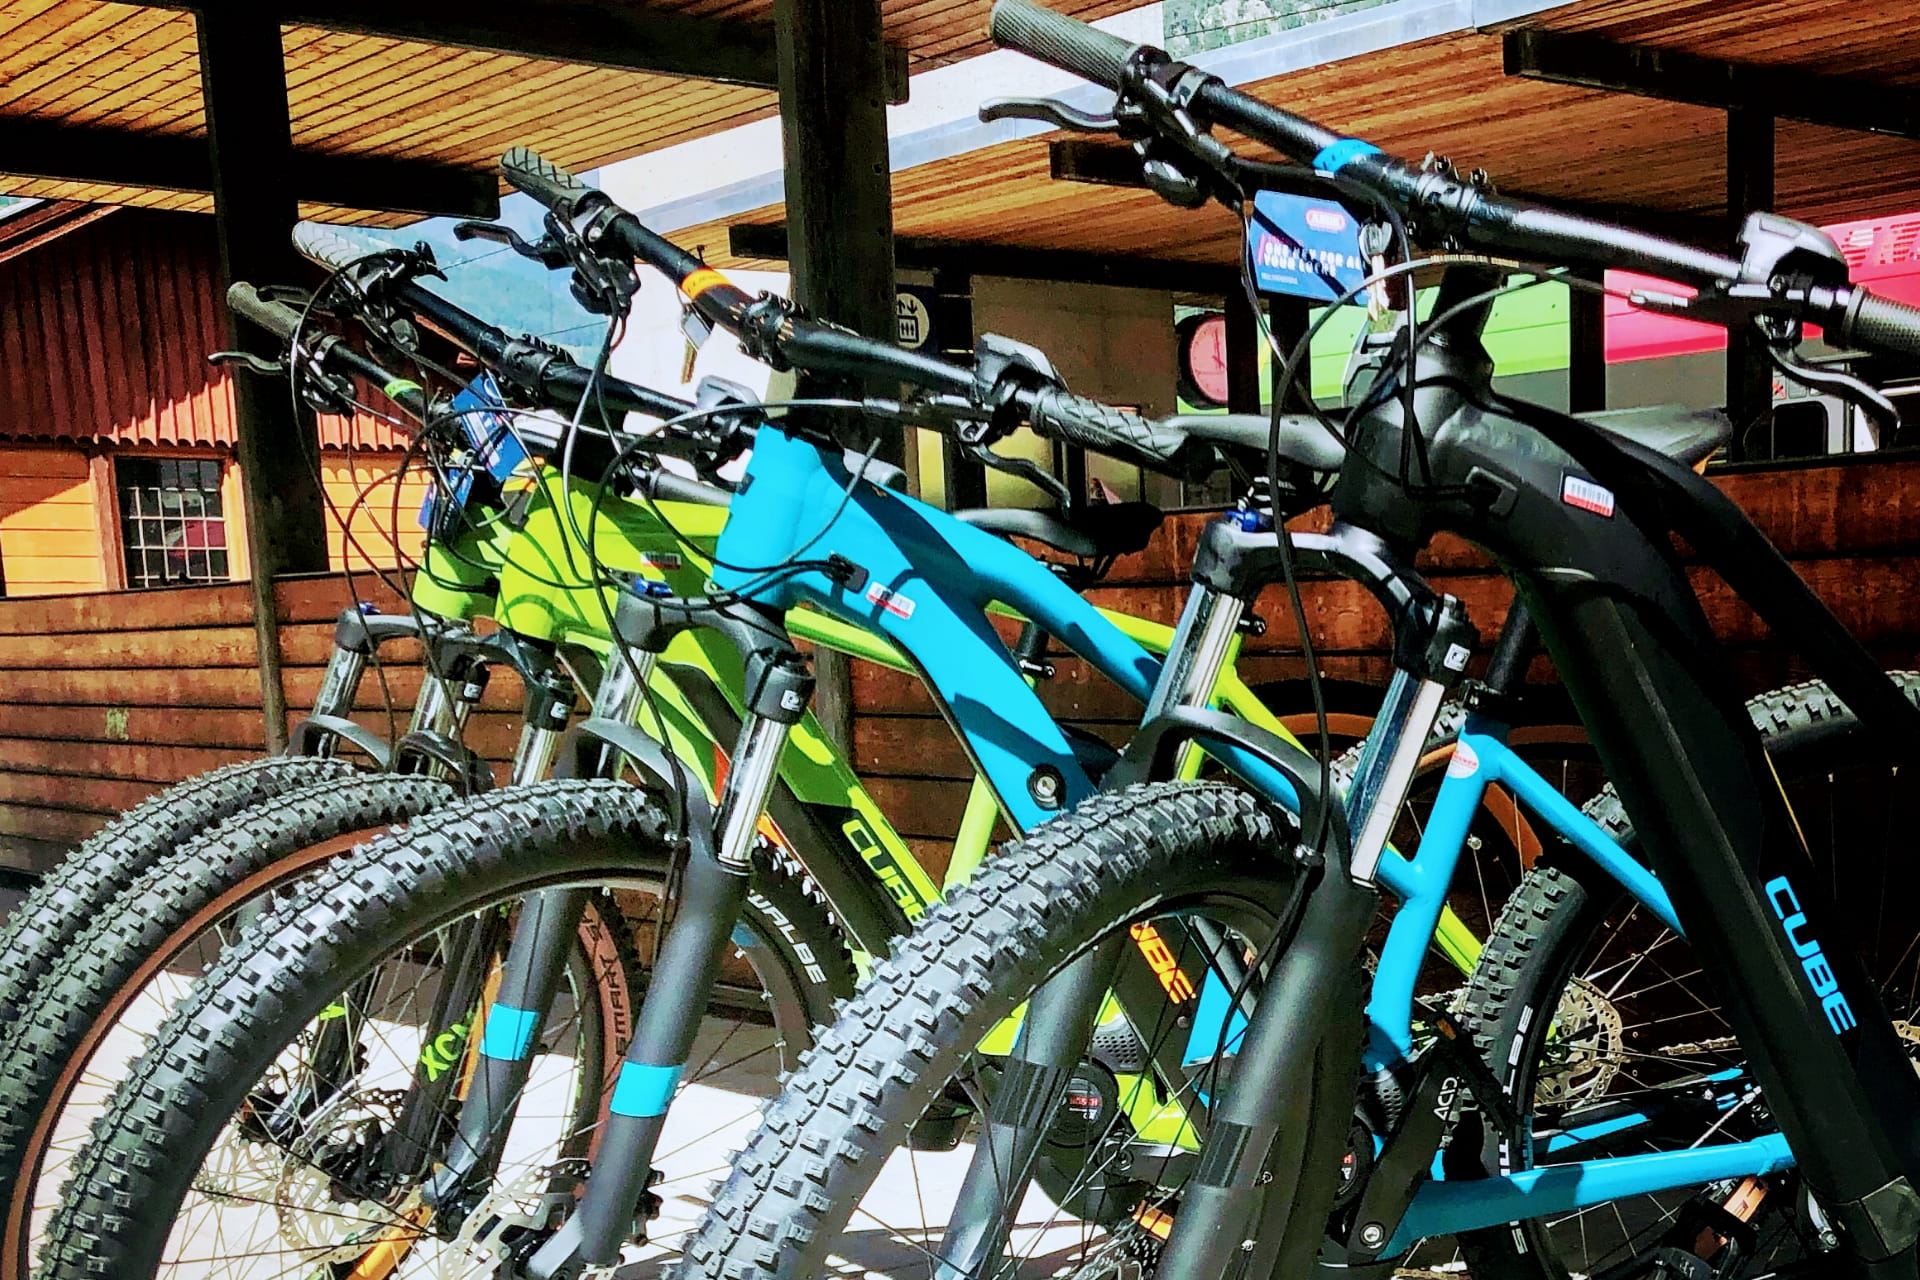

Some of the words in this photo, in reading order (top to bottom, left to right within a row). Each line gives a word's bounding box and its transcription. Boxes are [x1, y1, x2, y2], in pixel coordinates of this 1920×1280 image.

[1264, 254, 1296, 270] YOUR
[748, 889, 828, 984] WALBE
[1130, 921, 1194, 1004] UBE
[1765, 875, 1858, 1035] CUBE
[1433, 1077, 1458, 1121] ACID
